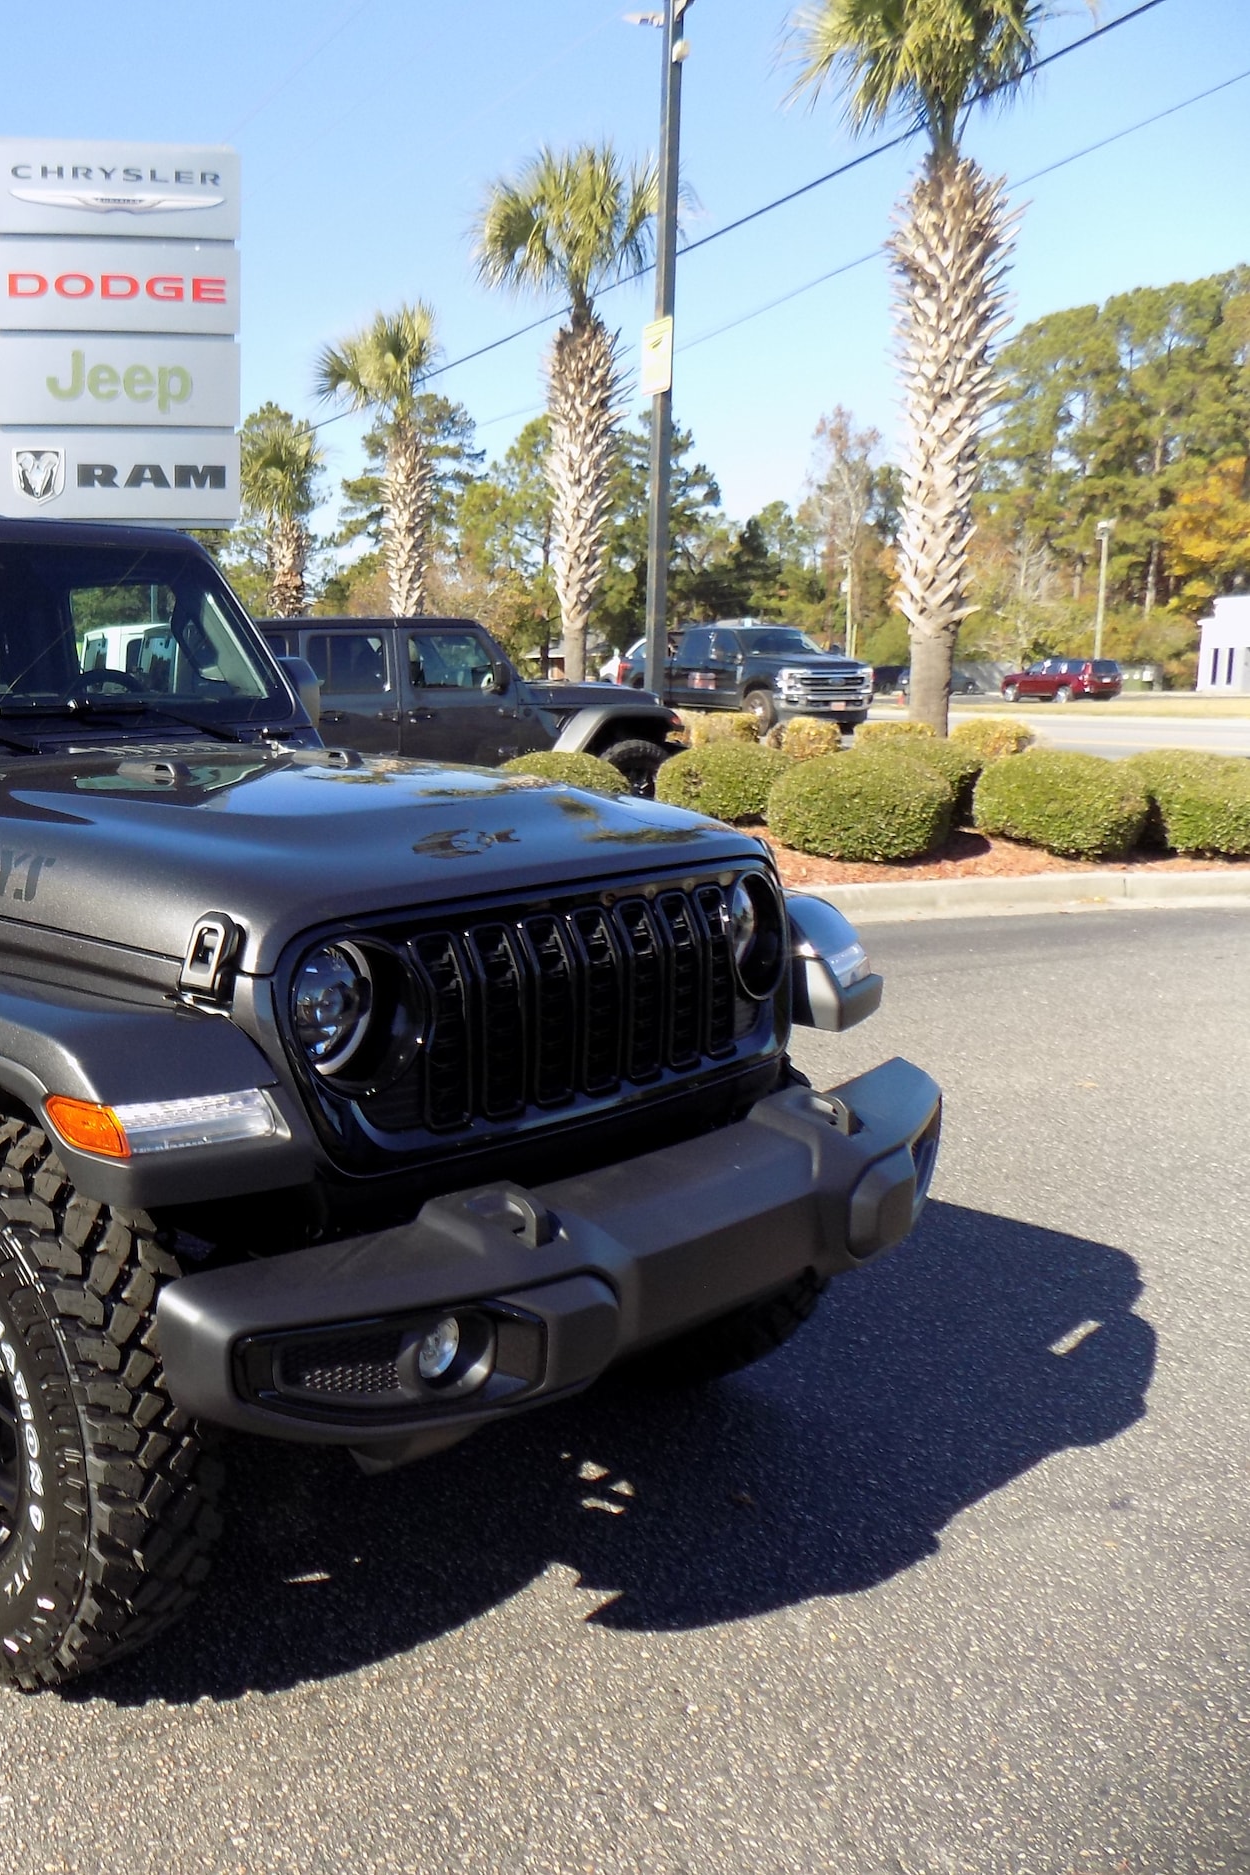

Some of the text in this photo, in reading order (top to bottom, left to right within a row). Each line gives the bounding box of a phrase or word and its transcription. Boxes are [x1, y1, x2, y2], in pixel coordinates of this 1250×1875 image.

[10, 164, 221, 187] CHRYSLER
[7, 272, 228, 304] DODGE
[45, 348, 193, 414] Jeep
[76, 463, 227, 490] RAM
